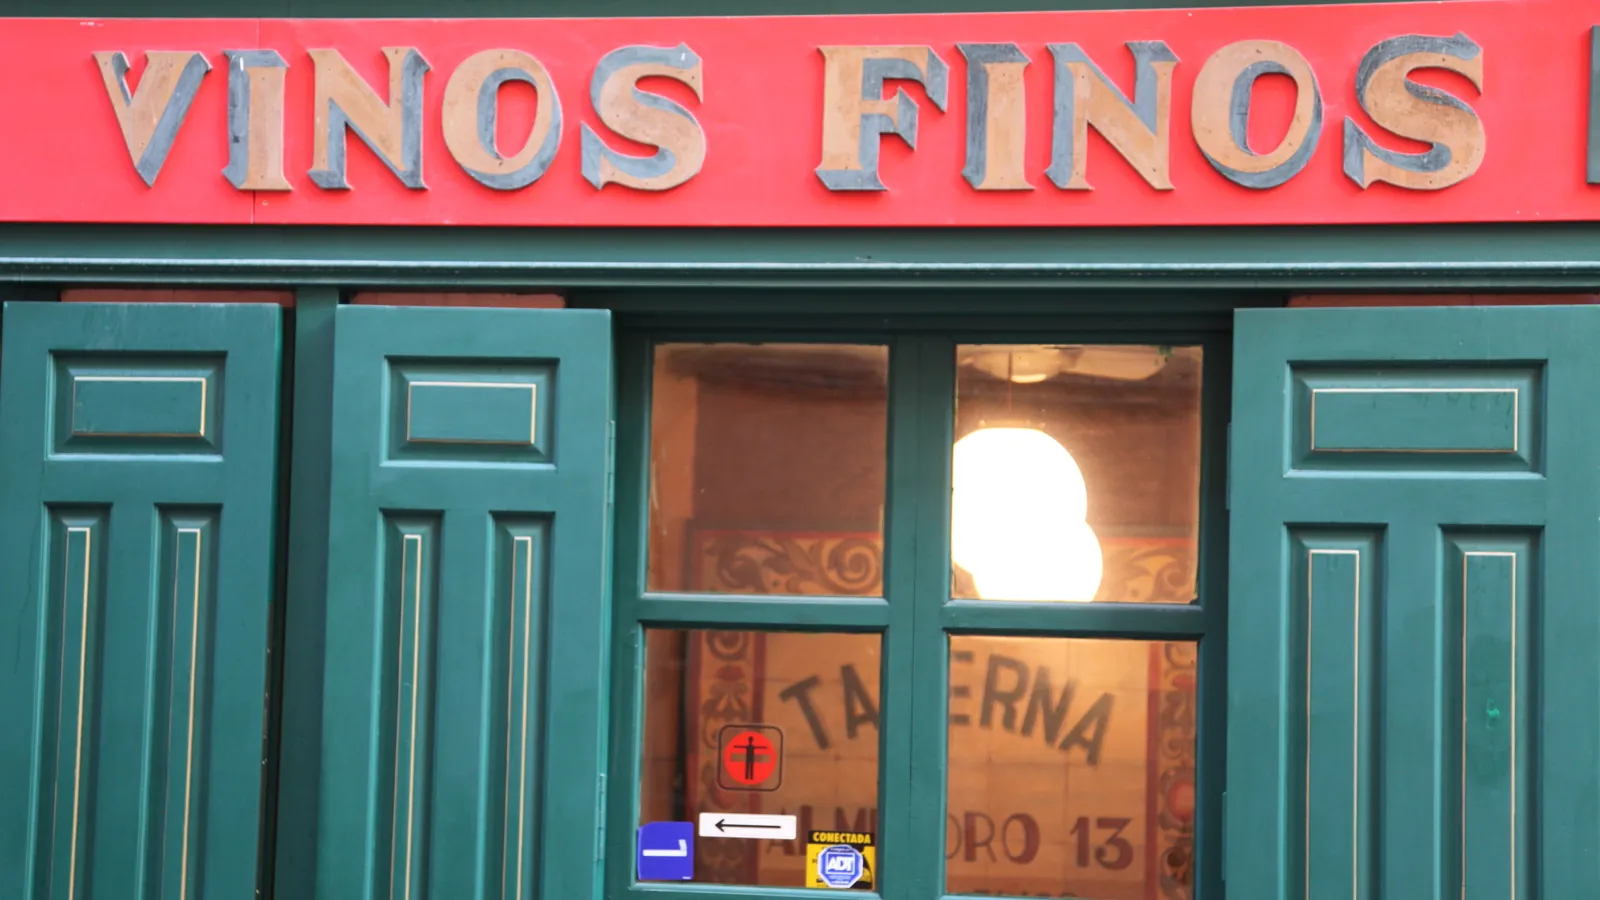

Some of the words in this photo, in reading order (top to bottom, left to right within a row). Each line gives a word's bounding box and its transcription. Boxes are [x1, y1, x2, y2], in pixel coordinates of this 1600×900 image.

[92, 42, 707, 192] VINOS
[815, 31, 1487, 192] FINOS
[778, 650, 1115, 767] TAERNA
[812, 831, 871, 844] CONECTADA
[827, 856, 854, 872] ADT
[1069, 816, 1135, 871] 13
